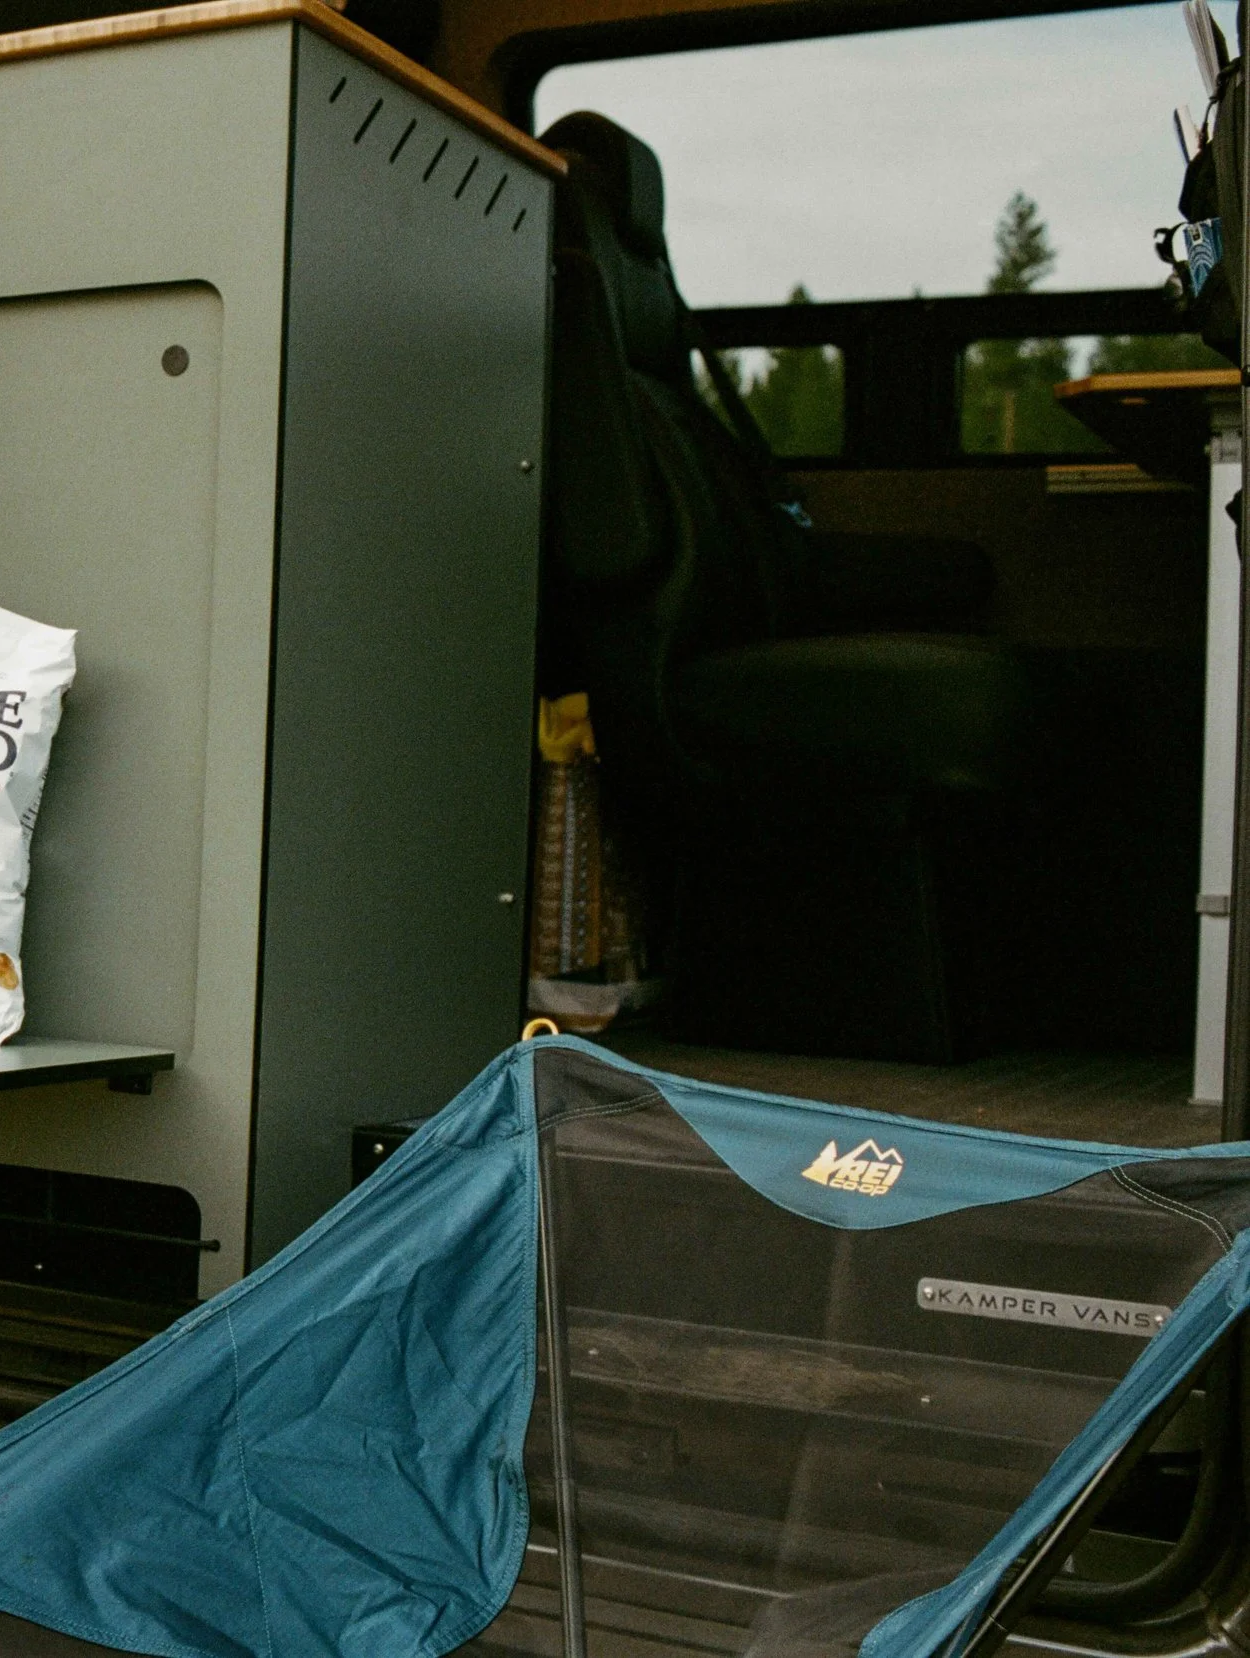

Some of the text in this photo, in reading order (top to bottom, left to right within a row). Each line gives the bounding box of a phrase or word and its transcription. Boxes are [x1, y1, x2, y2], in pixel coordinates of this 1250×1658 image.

[834, 1160, 903, 1188] REI
[938, 1287, 1151, 1328] KAMPER VANS
